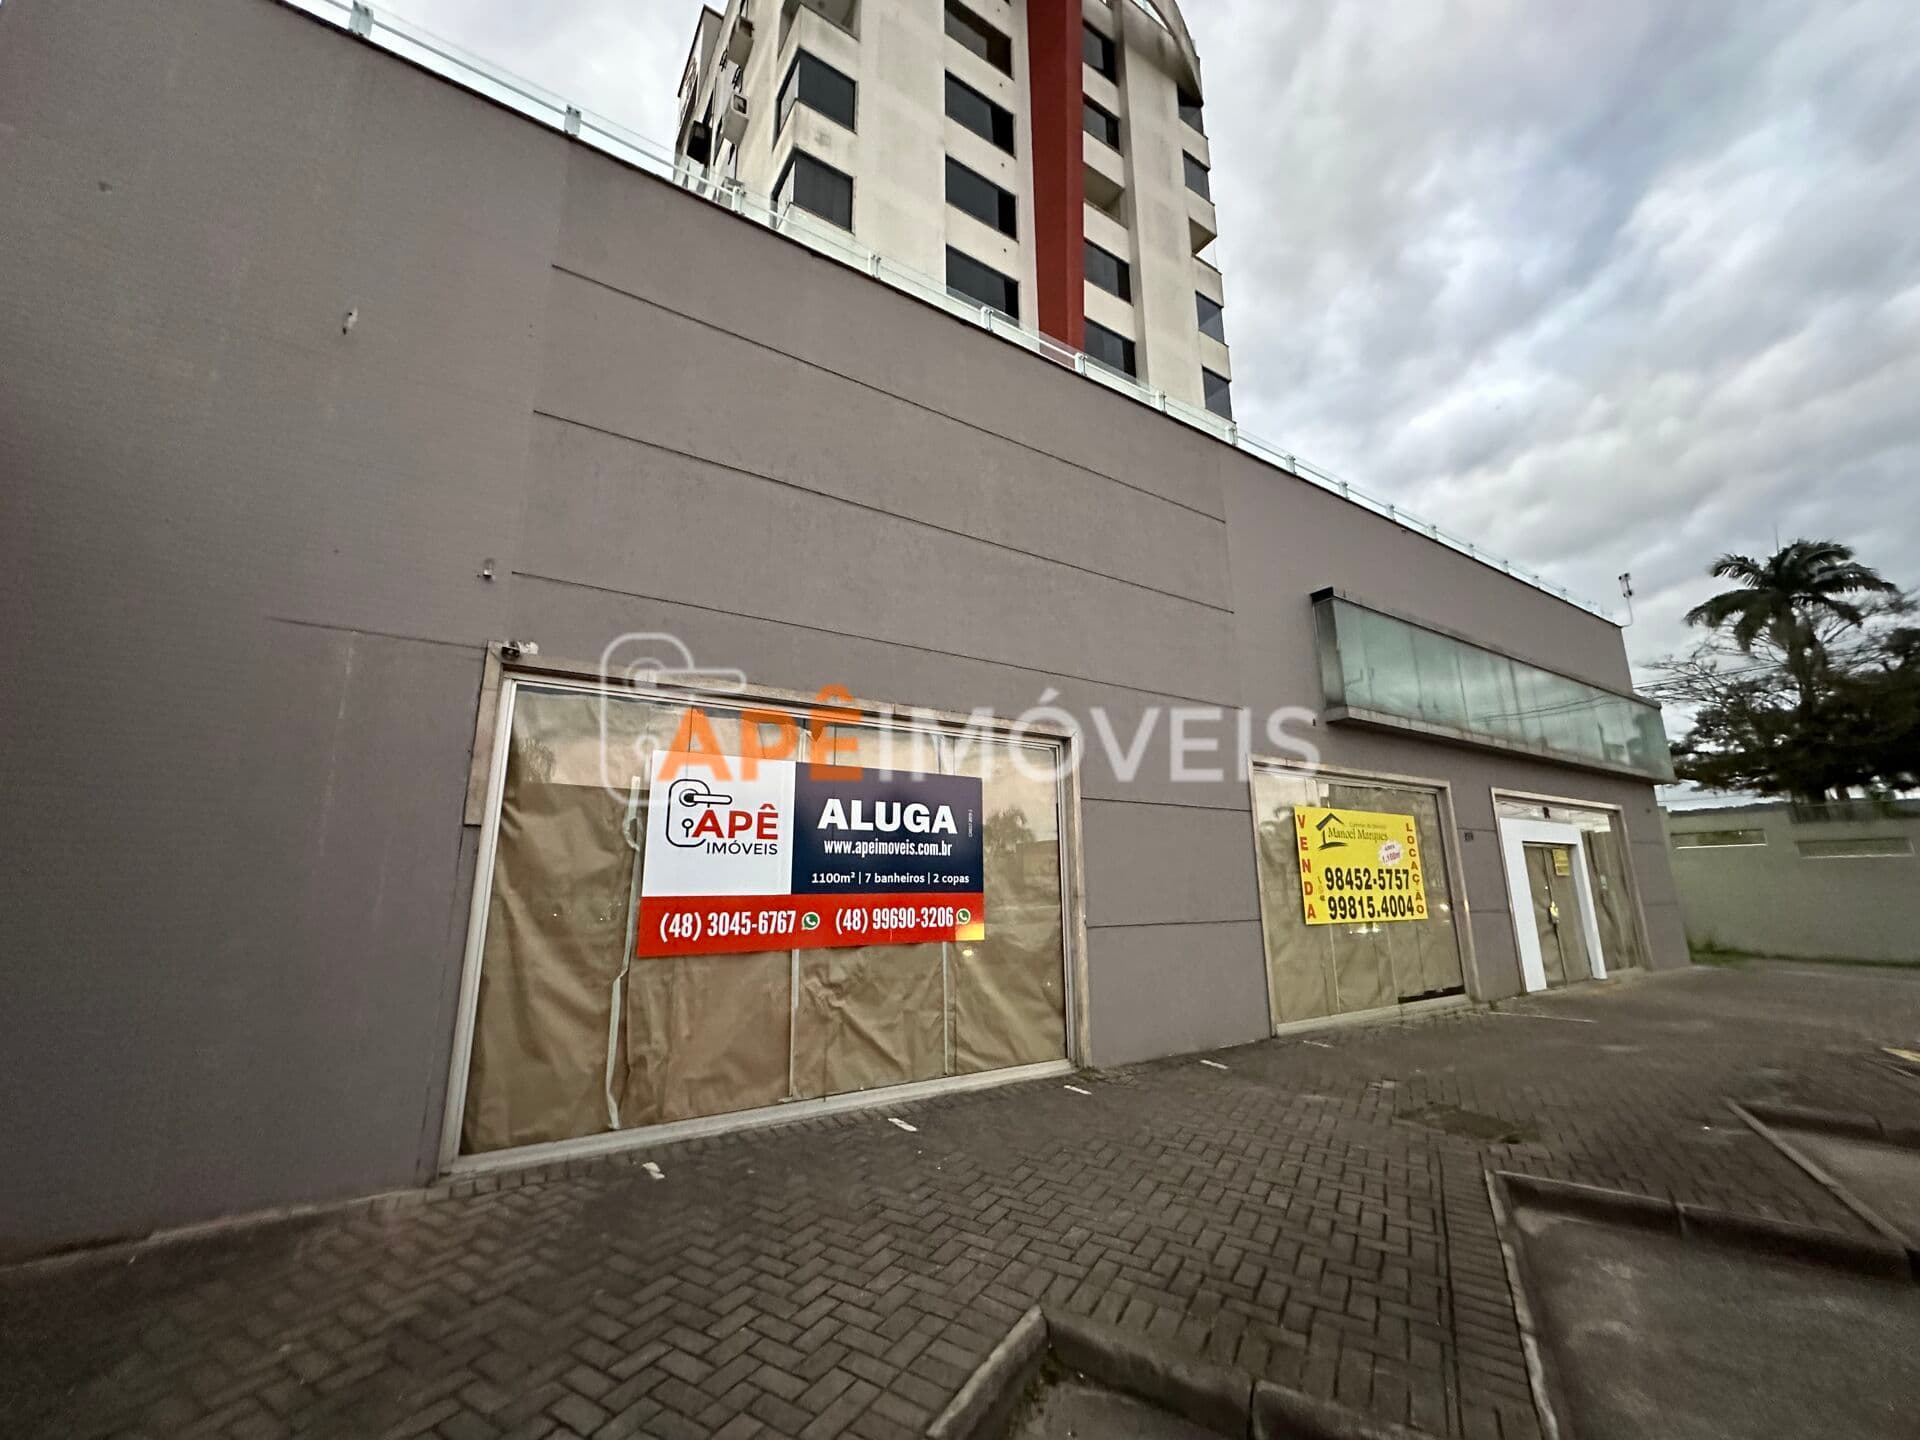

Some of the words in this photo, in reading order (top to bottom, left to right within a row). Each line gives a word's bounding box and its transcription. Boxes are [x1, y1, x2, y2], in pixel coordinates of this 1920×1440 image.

[691, 803, 779, 840] APÊ
[817, 798, 958, 835] ALUGA
[706, 840, 778, 855] IMÓVEIS
[823, 838, 953, 858] www.apeimoveis.com.br
[811, 872, 856, 884] 1100m²
[865, 873, 871, 884] 7
[874, 872, 925, 884] banheiros
[933, 874, 940, 884] 2
[941, 874, 970, 886] copas
[1296, 814, 1317, 920] VENDA
[835, 907, 869, 935] (48)
[872, 906, 954, 930] 99690-3206
[1327, 895, 1415, 920] 99815.4004
[660, 911, 702, 943] (48)
[706, 910, 797, 937] 3045-6767
